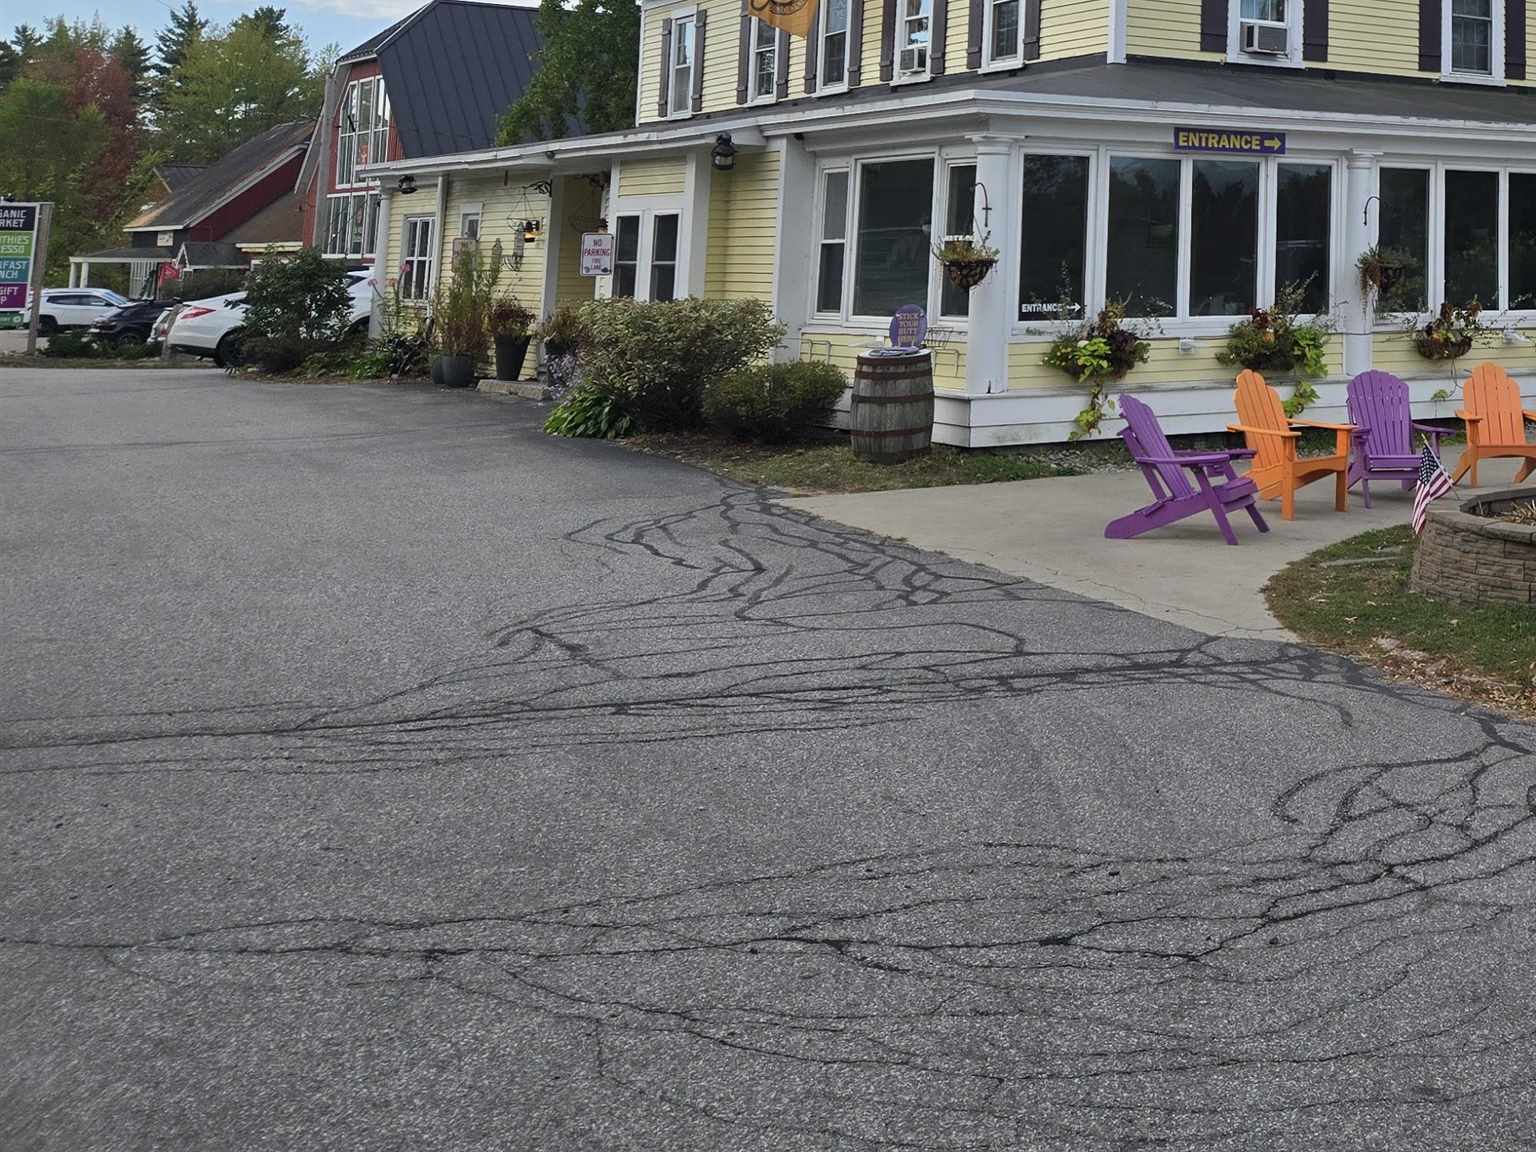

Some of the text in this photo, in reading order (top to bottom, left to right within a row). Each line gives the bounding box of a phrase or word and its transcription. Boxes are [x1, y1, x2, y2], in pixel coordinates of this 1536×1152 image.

[1179, 132, 1261, 149] ENTRANCE
[593, 239, 602, 247] NO
[0, 260, 27, 270] FAST
[1021, 303, 1064, 313] ENTRANCE
